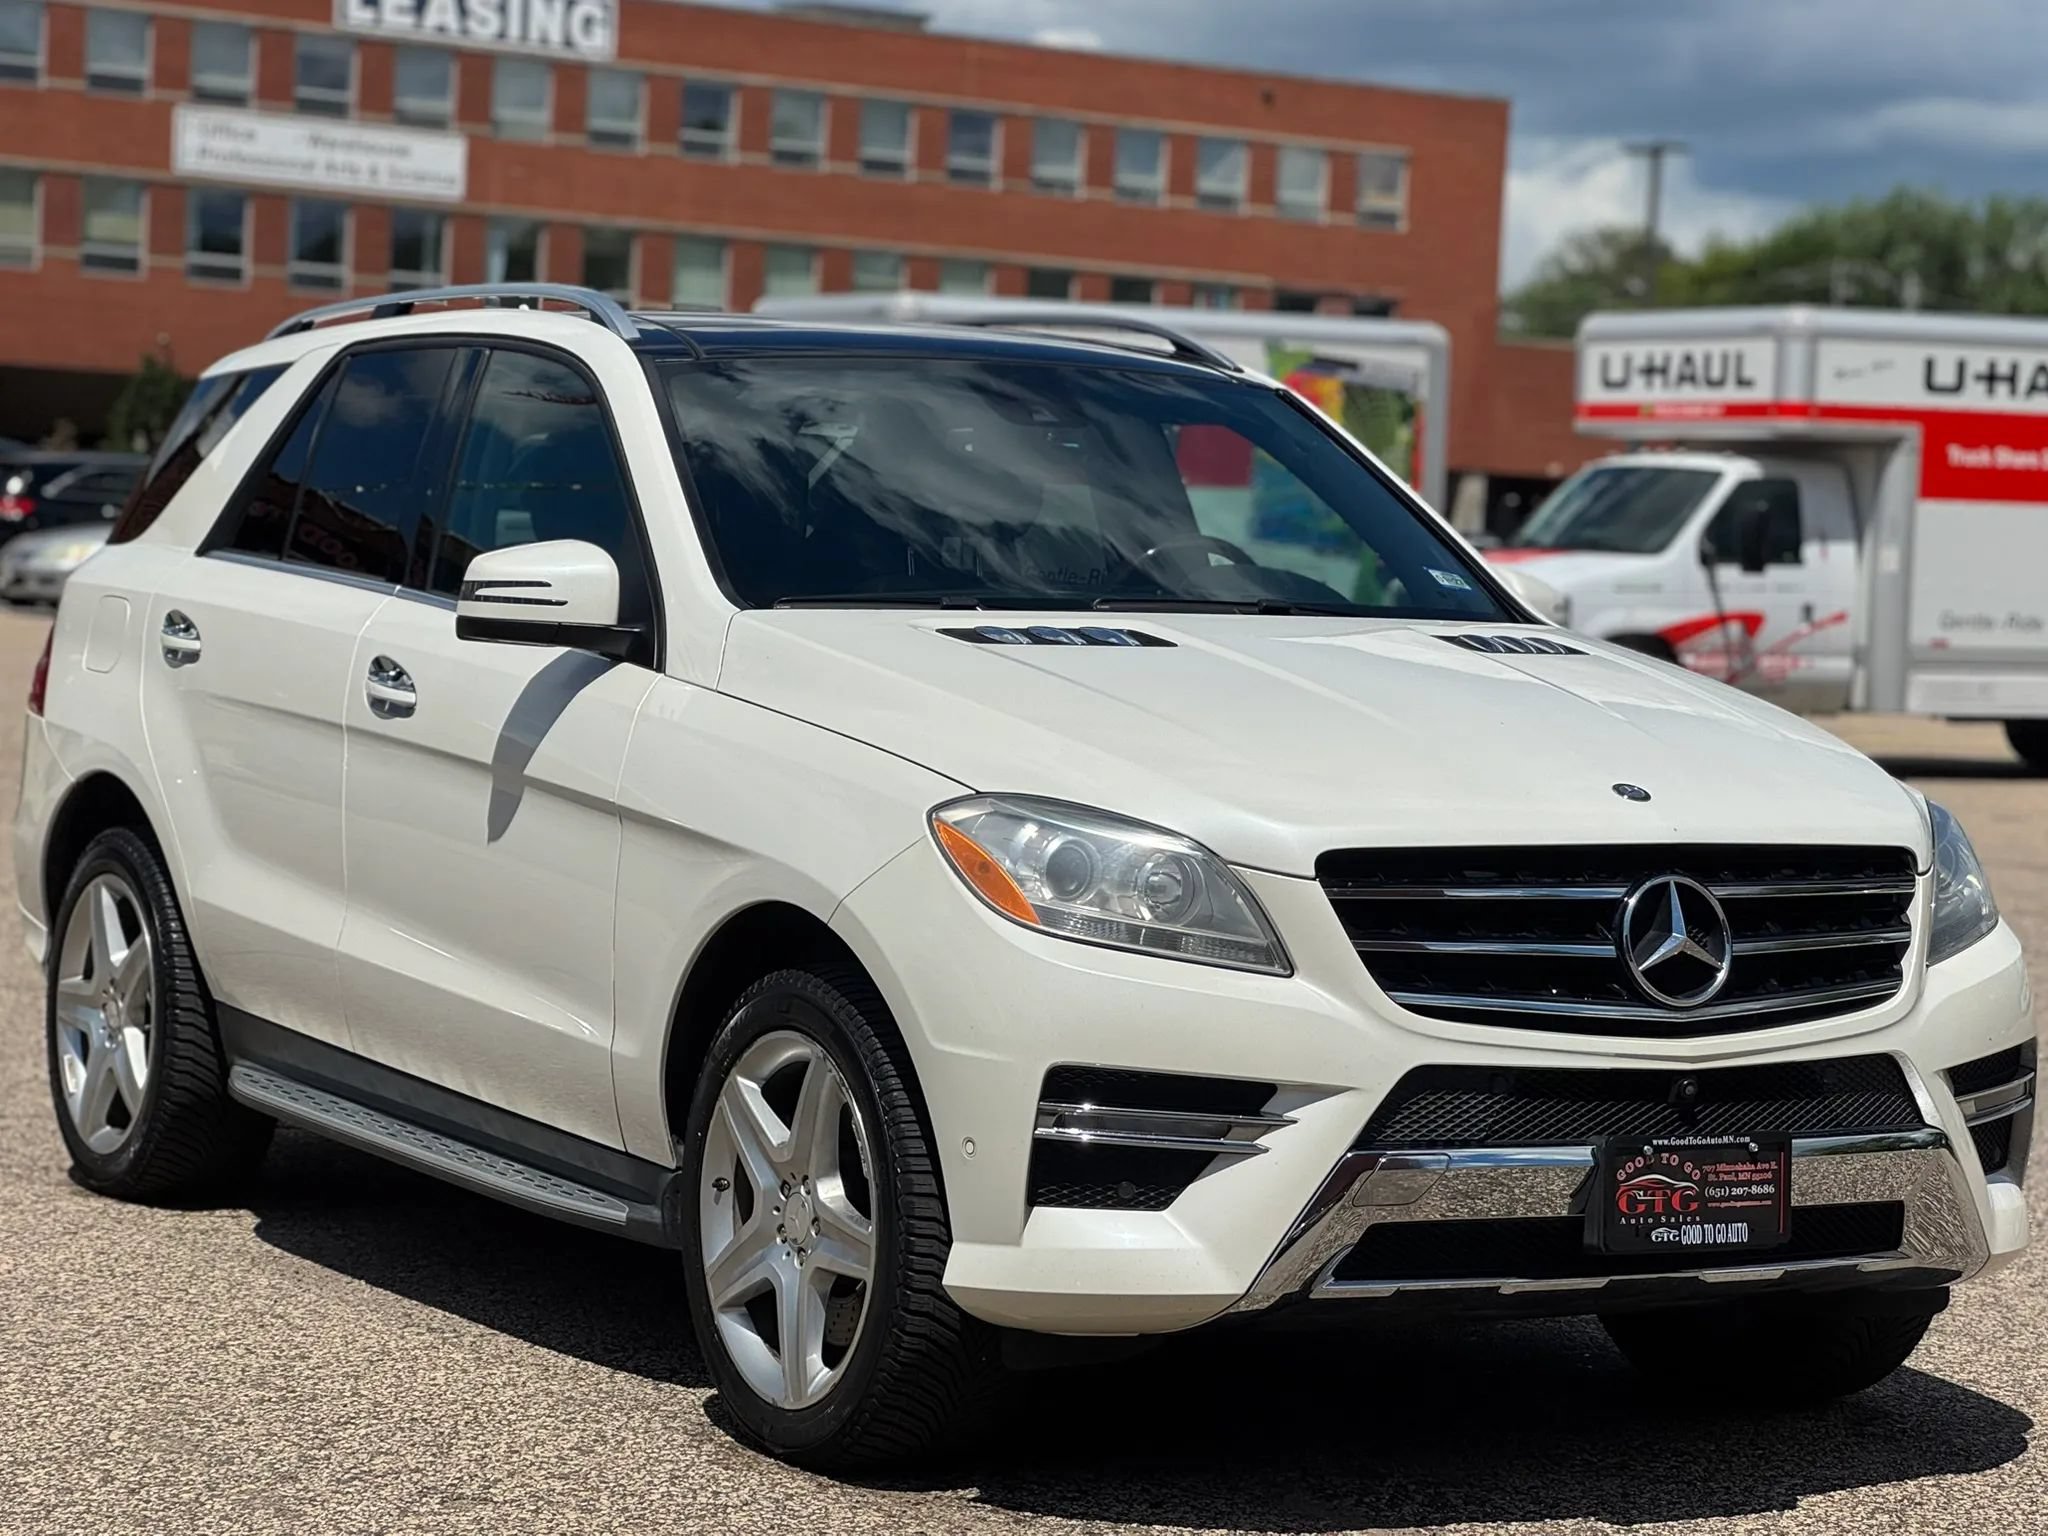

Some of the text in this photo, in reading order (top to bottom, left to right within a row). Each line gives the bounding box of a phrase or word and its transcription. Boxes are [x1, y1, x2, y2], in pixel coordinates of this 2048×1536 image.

[344, 0, 610, 49] LEASING
[196, 121, 257, 143] Office
[1600, 351, 1756, 392] U-HAUL
[1652, 1135, 1751, 1146] www.GoodToGoAutoMN.com
[1661, 1152, 1680, 1167] TO
[1683, 1161, 1702, 1181] GO
[1704, 1183, 1776, 1198] (651) 207-8686
[1619, 1214, 1701, 1225] Auto Sales
[1681, 1224, 1702, 1245] GOOD
[1703, 1223, 1714, 1244] TO
[1715, 1223, 1727, 1244] GO
[1727, 1222, 1748, 1243] AUTO
